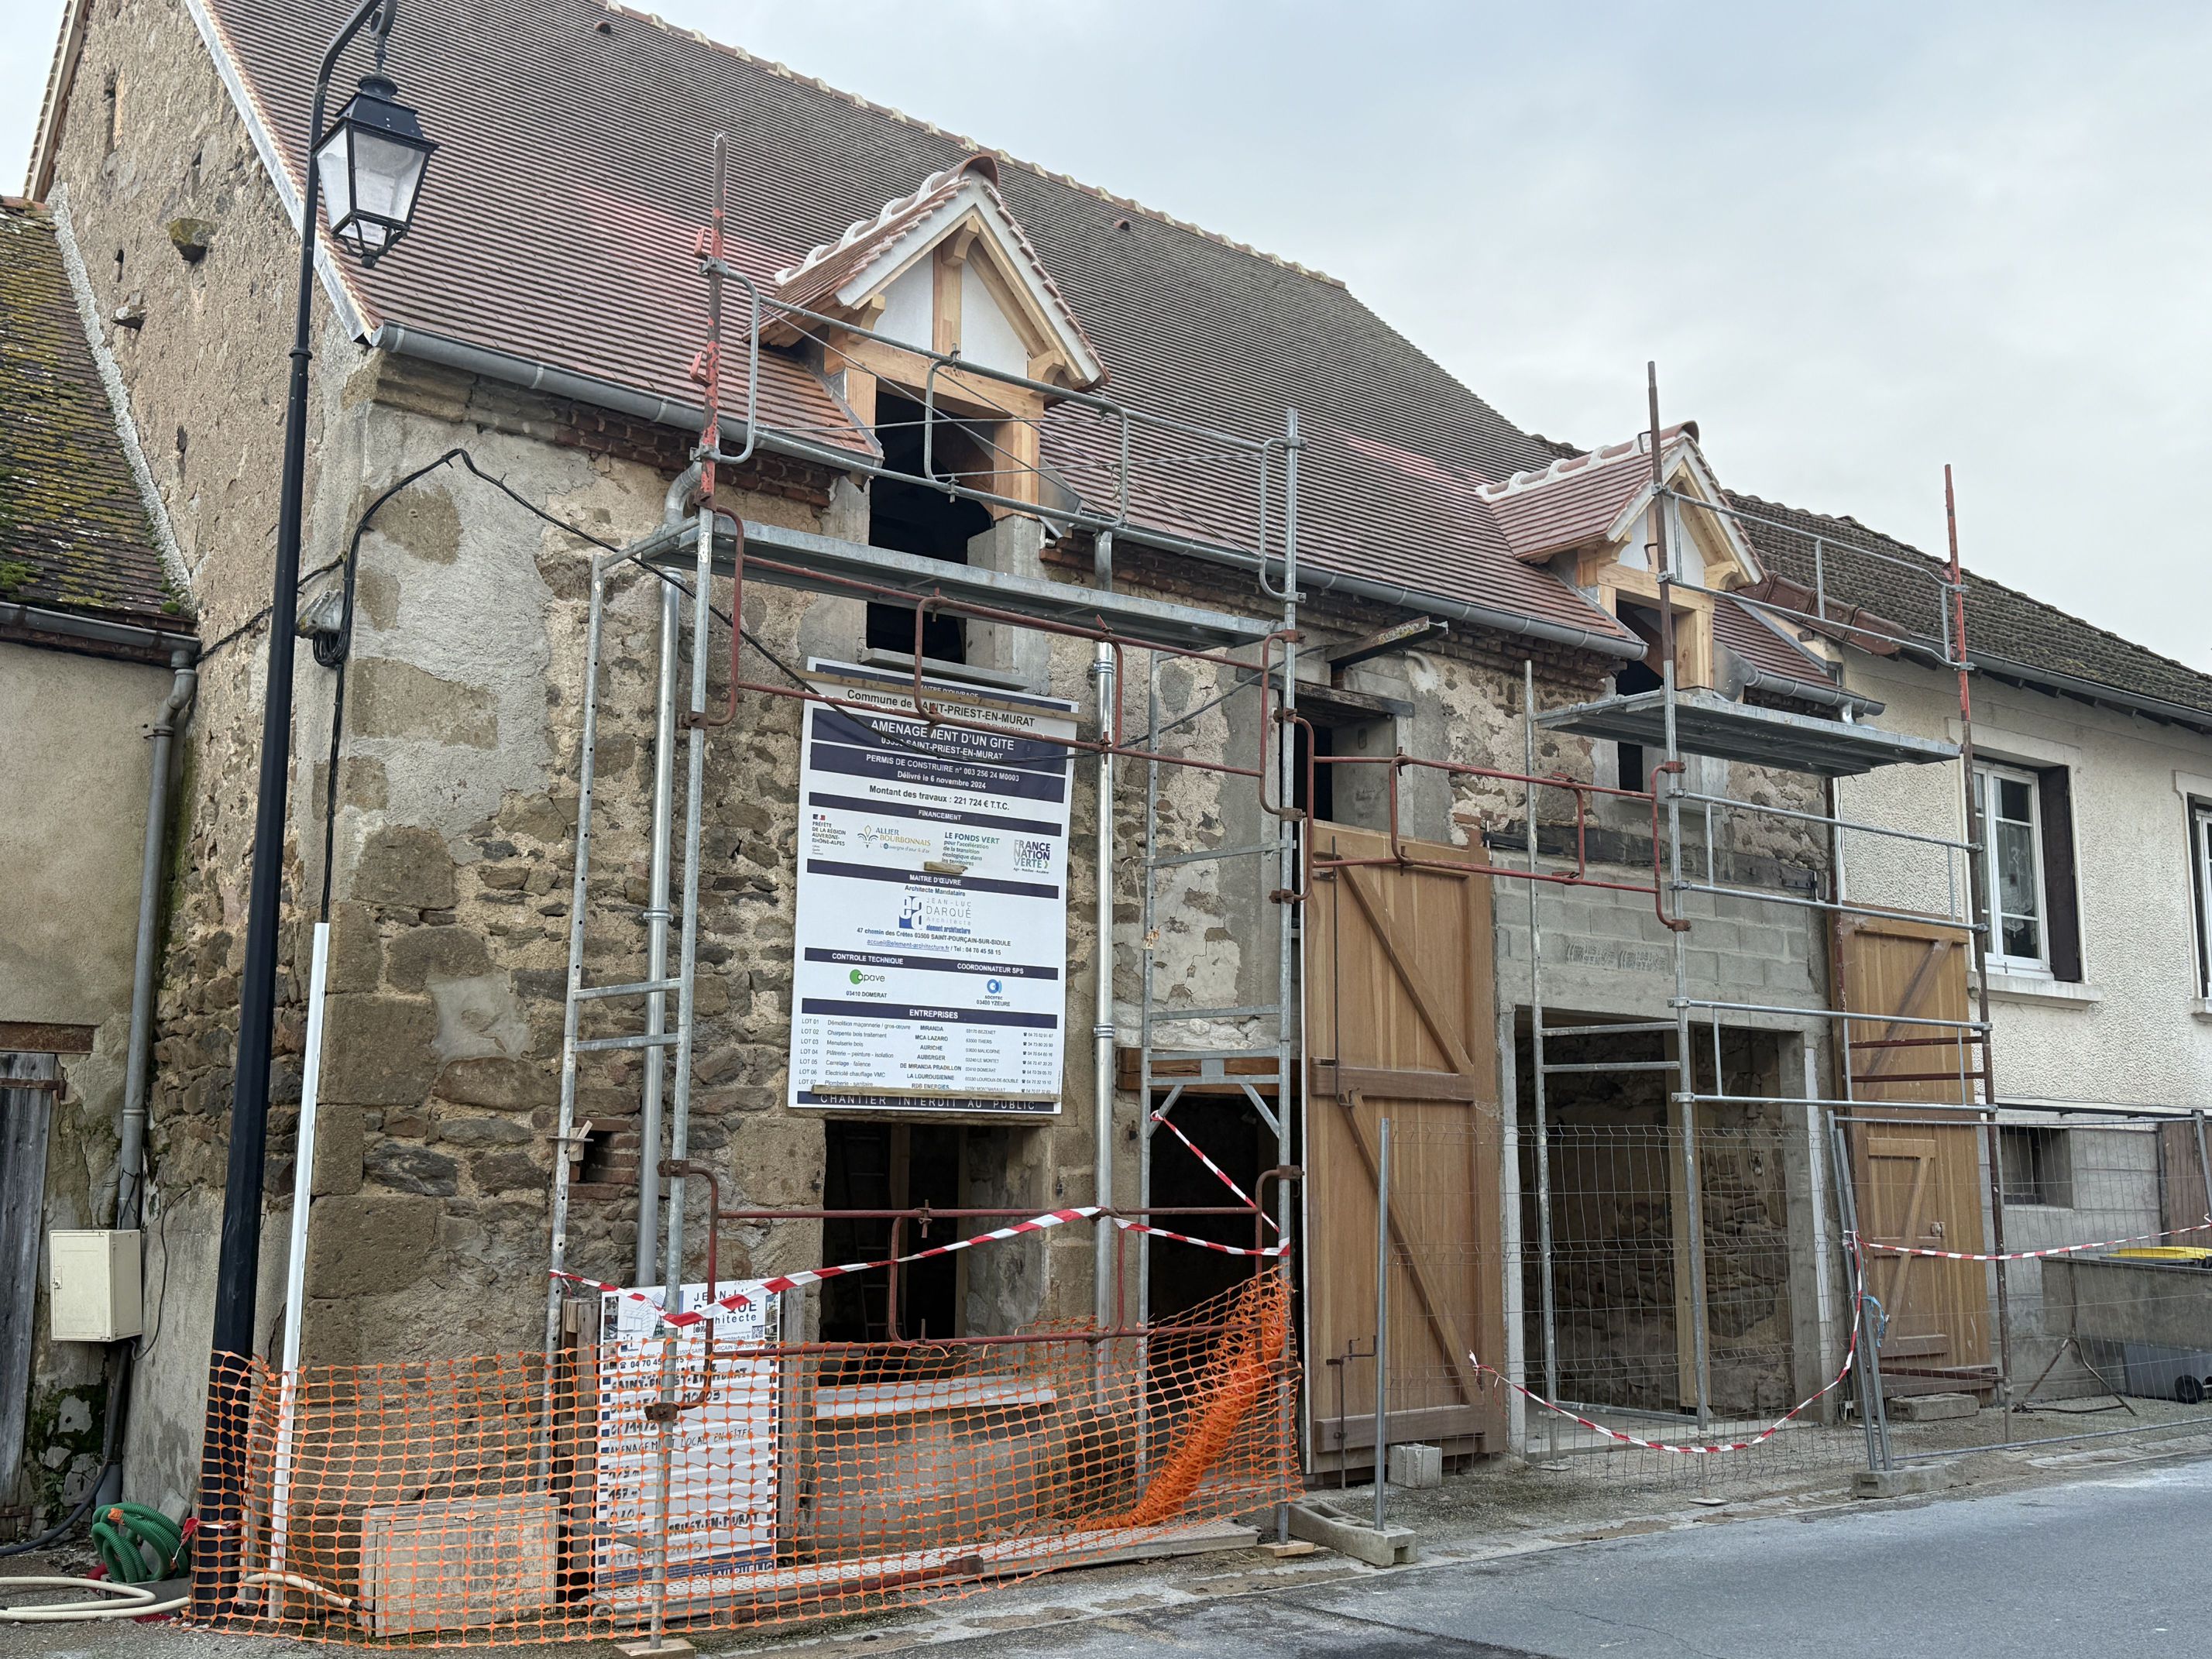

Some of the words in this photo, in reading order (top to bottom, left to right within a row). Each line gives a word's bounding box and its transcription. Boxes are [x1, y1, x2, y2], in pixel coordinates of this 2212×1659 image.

[847, 689, 898, 706] Commune
[900, 698, 912, 707] de
[919, 701, 1035, 726] AINT-PRIEST-EN-MURAT
[961, 731, 988, 747] D'UN
[990, 737, 1015, 750] GITE
[866, 754, 894, 764] PERMIS
[895, 757, 906, 766] DE
[907, 759, 953, 773] CONSTRUIRE
[977, 769, 988, 778] 256
[999, 772, 1020, 782] M0003
[897, 770, 921, 781] Délivré
[936, 776, 970, 787] novembre
[970, 780, 986, 789] 2024
[869, 785, 901, 796] Montant
[903, 788, 917, 799] des
[919, 792, 947, 802] travaux
[953, 796, 967, 805] 221
[969, 798, 982, 807] 724
[991, 800, 1010, 811] T.T.C.
[918, 809, 962, 821] FINANCEMENT
[875, 827, 899, 836] ALLIER
[944, 831, 953, 840] LE
[954, 833, 980, 843] FONDS
[981, 836, 1001, 844] VERT
[880, 834, 931, 847] BOURBONNAIS
[1014, 839, 1051, 852] FRANCE
[942, 852, 970, 860] écologique
[1014, 848, 1050, 860] NATION
[1014, 857, 1042, 868] VERTE
[909, 874, 933, 883] MAITRE
[905, 884, 934, 894] Architecte
[935, 888, 966, 897] Mandataire
[926, 898, 971, 907] JEAN-LUC
[926, 905, 971, 919] DARQUÉ
[926, 916, 971, 926] Architecte
[832, 953, 867, 963] CONTROLE
[867, 956, 904, 965] TECHNIQUE
[957, 963, 1012, 974] COORDONNATEUR
[1012, 967, 1025, 975] SPS
[857, 972, 885, 982] apave
[909, 1008, 959, 1020] ENTREPRISES
[820, 1094, 886, 1105] CHANTIER
[968, 1100, 982, 1108] AU
[993, 1101, 1035, 1109] PUBLIC
[693, 1314, 757, 1327] hitecte
[630, 1360, 640, 1369] 04
[642, 1358, 651, 1367] 70
[733, 1562, 773, 1575] PUBLIC
